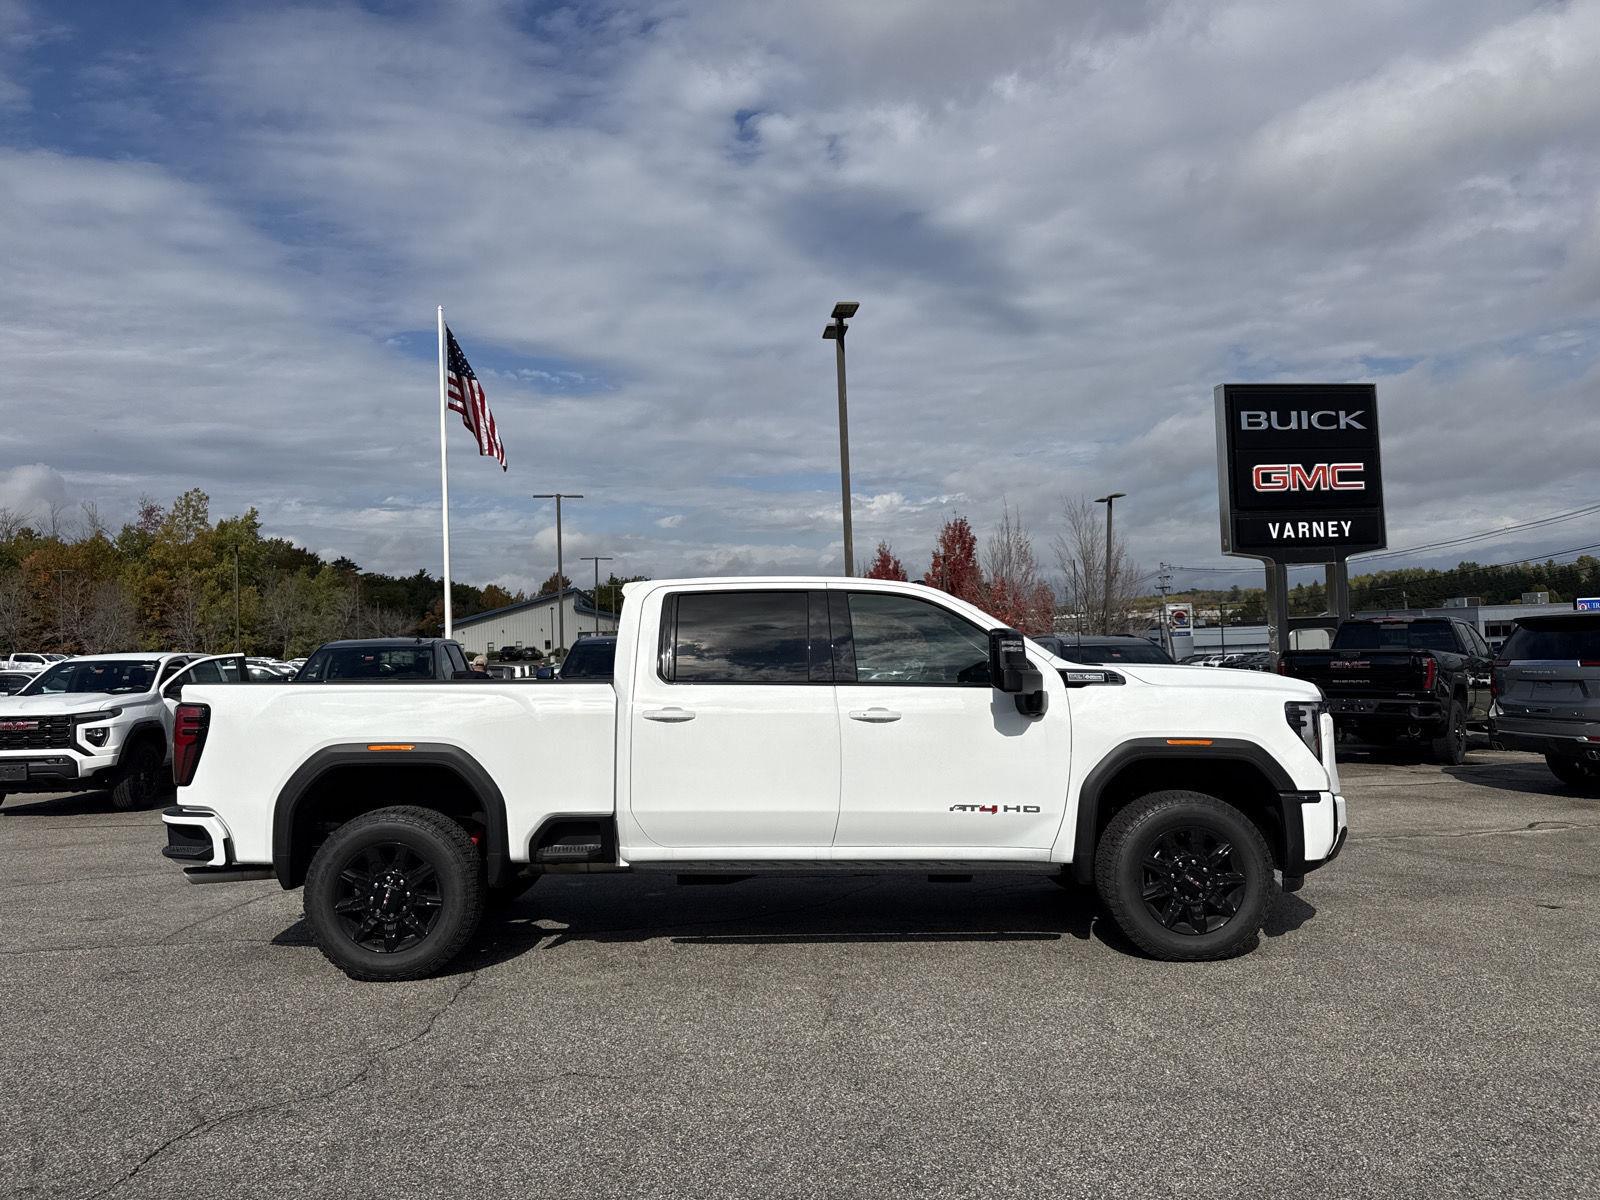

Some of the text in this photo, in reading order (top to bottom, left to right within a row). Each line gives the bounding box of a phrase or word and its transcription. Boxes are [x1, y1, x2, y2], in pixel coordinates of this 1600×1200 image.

[1240, 410, 1367, 430] BUICK
[1252, 463, 1366, 492] GMC
[1268, 521, 1352, 539] VARNEY
[949, 804, 1041, 815] AT4 HD
